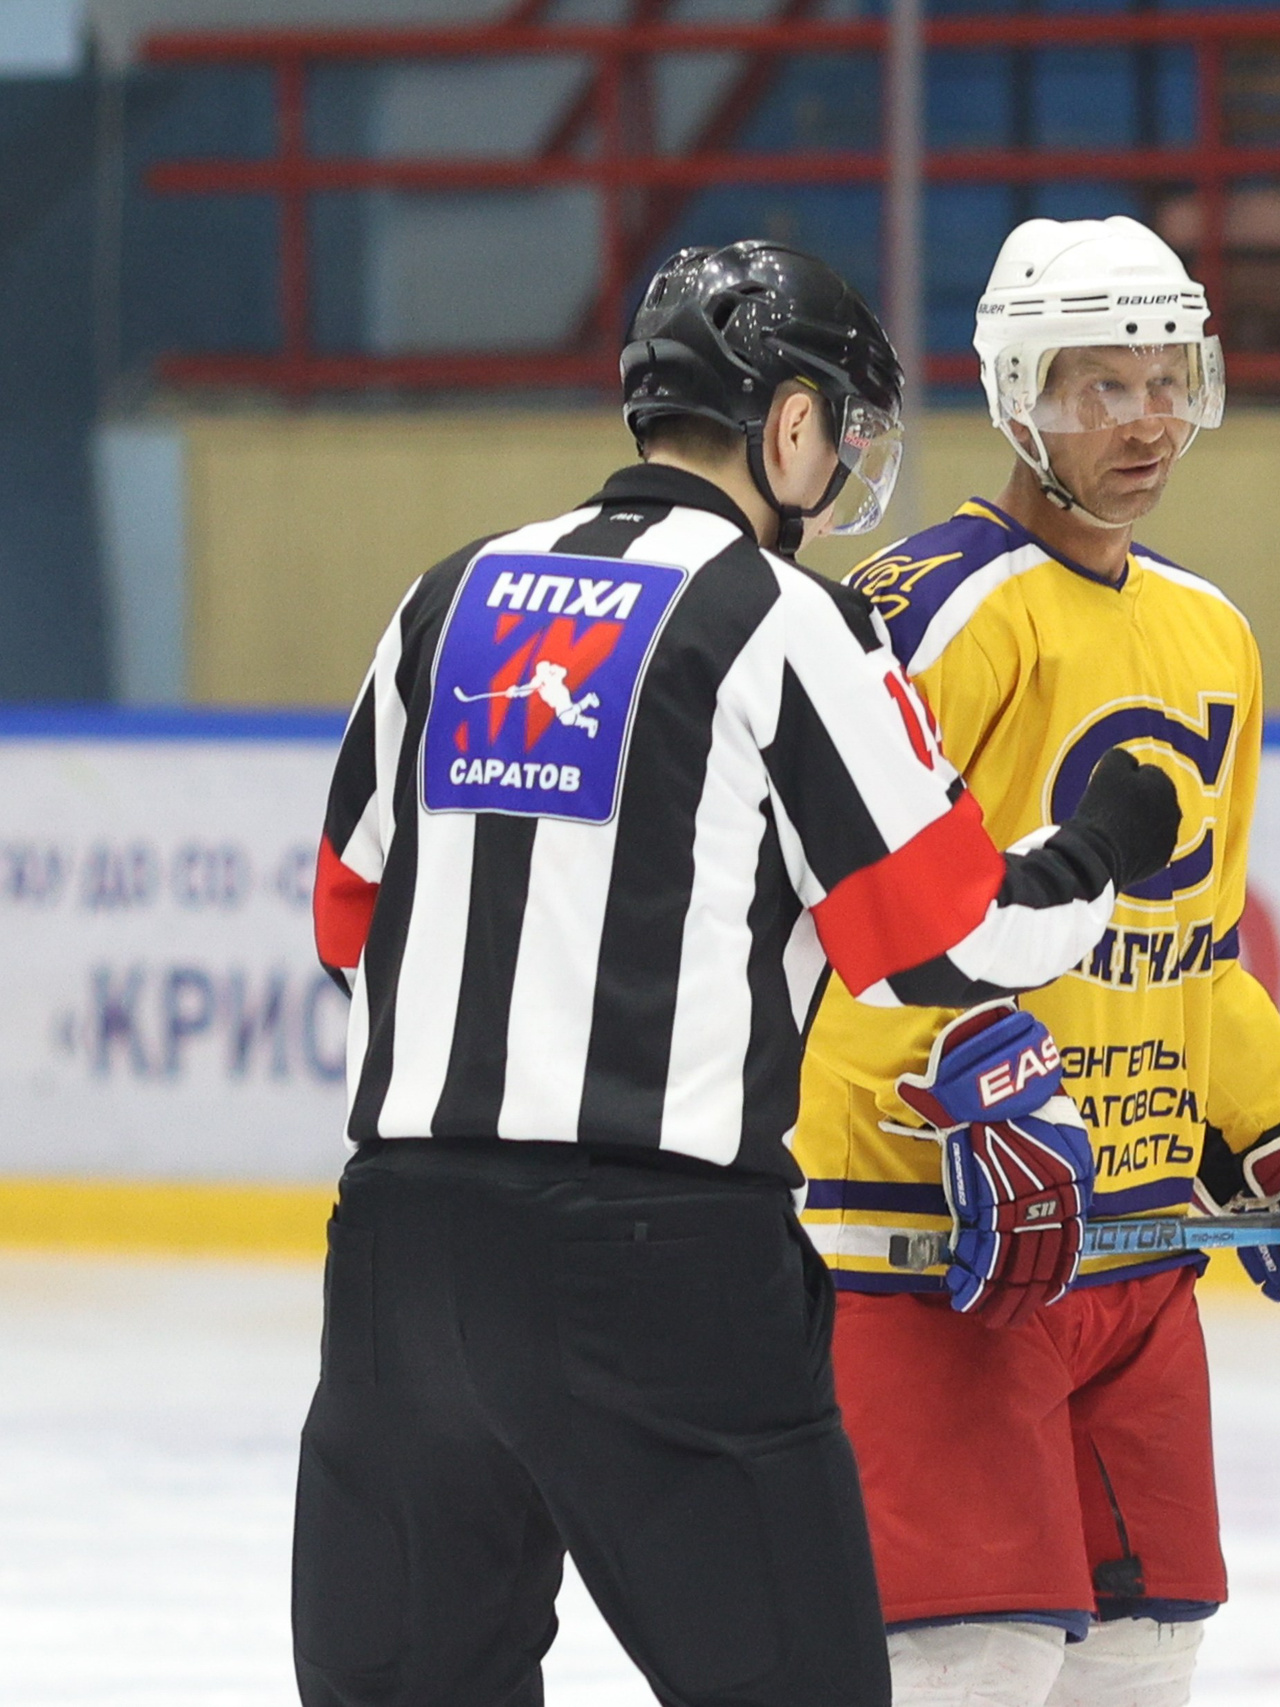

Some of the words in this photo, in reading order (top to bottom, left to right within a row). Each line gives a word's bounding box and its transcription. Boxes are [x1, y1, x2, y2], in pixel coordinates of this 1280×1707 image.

[1117, 294, 1178, 305] BAUER
[486, 572, 643, 619] НПХЛ
[450, 758, 580, 791] САРАТОВ
[1060, 1040, 1187, 1078] ЭНГЕЛЬ
[1072, 1087, 1208, 1127] АТОВСК
